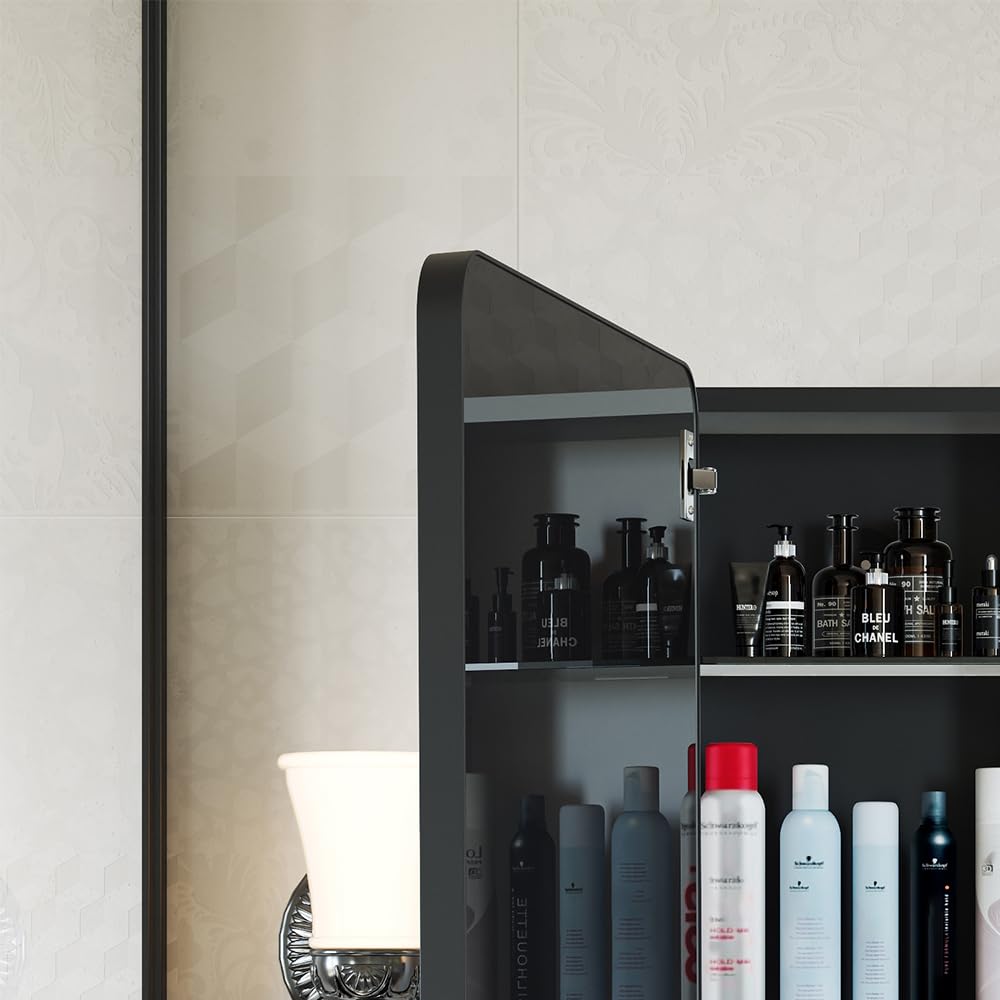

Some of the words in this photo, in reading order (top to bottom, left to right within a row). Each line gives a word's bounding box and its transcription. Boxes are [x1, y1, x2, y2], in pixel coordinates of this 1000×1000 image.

[817, 619, 839, 628] BATH
[861, 612, 891, 624] BLEU
[854, 632, 899, 644] CHANEL
